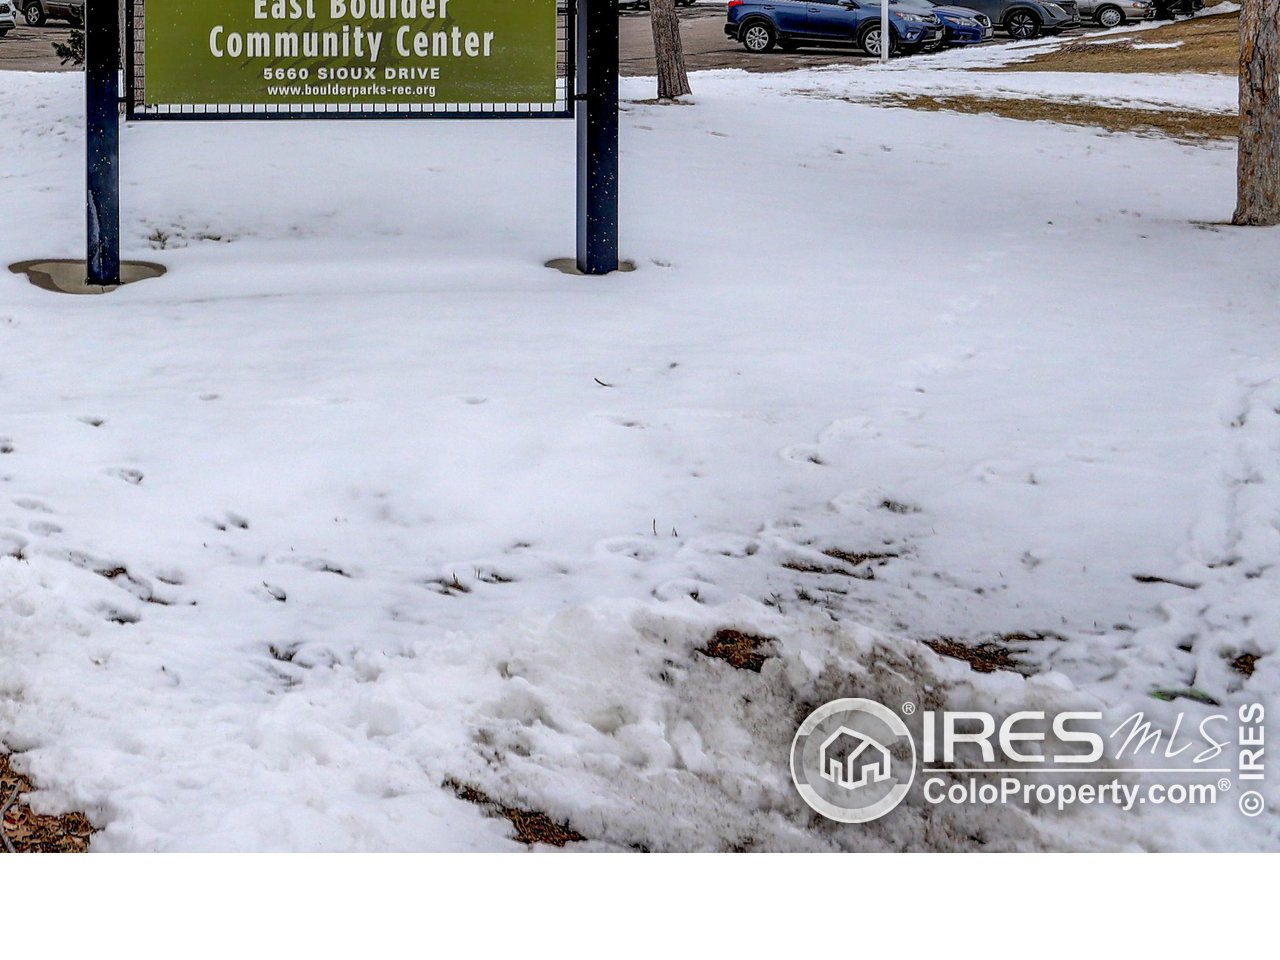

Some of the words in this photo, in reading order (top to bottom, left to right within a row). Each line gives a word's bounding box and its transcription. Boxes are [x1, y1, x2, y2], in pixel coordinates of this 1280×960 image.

[209, 25, 383, 62] Community
[396, 25, 495, 57] Center
[263, 67, 310, 80] 5660
[317, 67, 377, 80] SIOUX
[384, 67, 441, 80] DRIVE
[267, 83, 437, 98] www.boulderparks-rec.org
